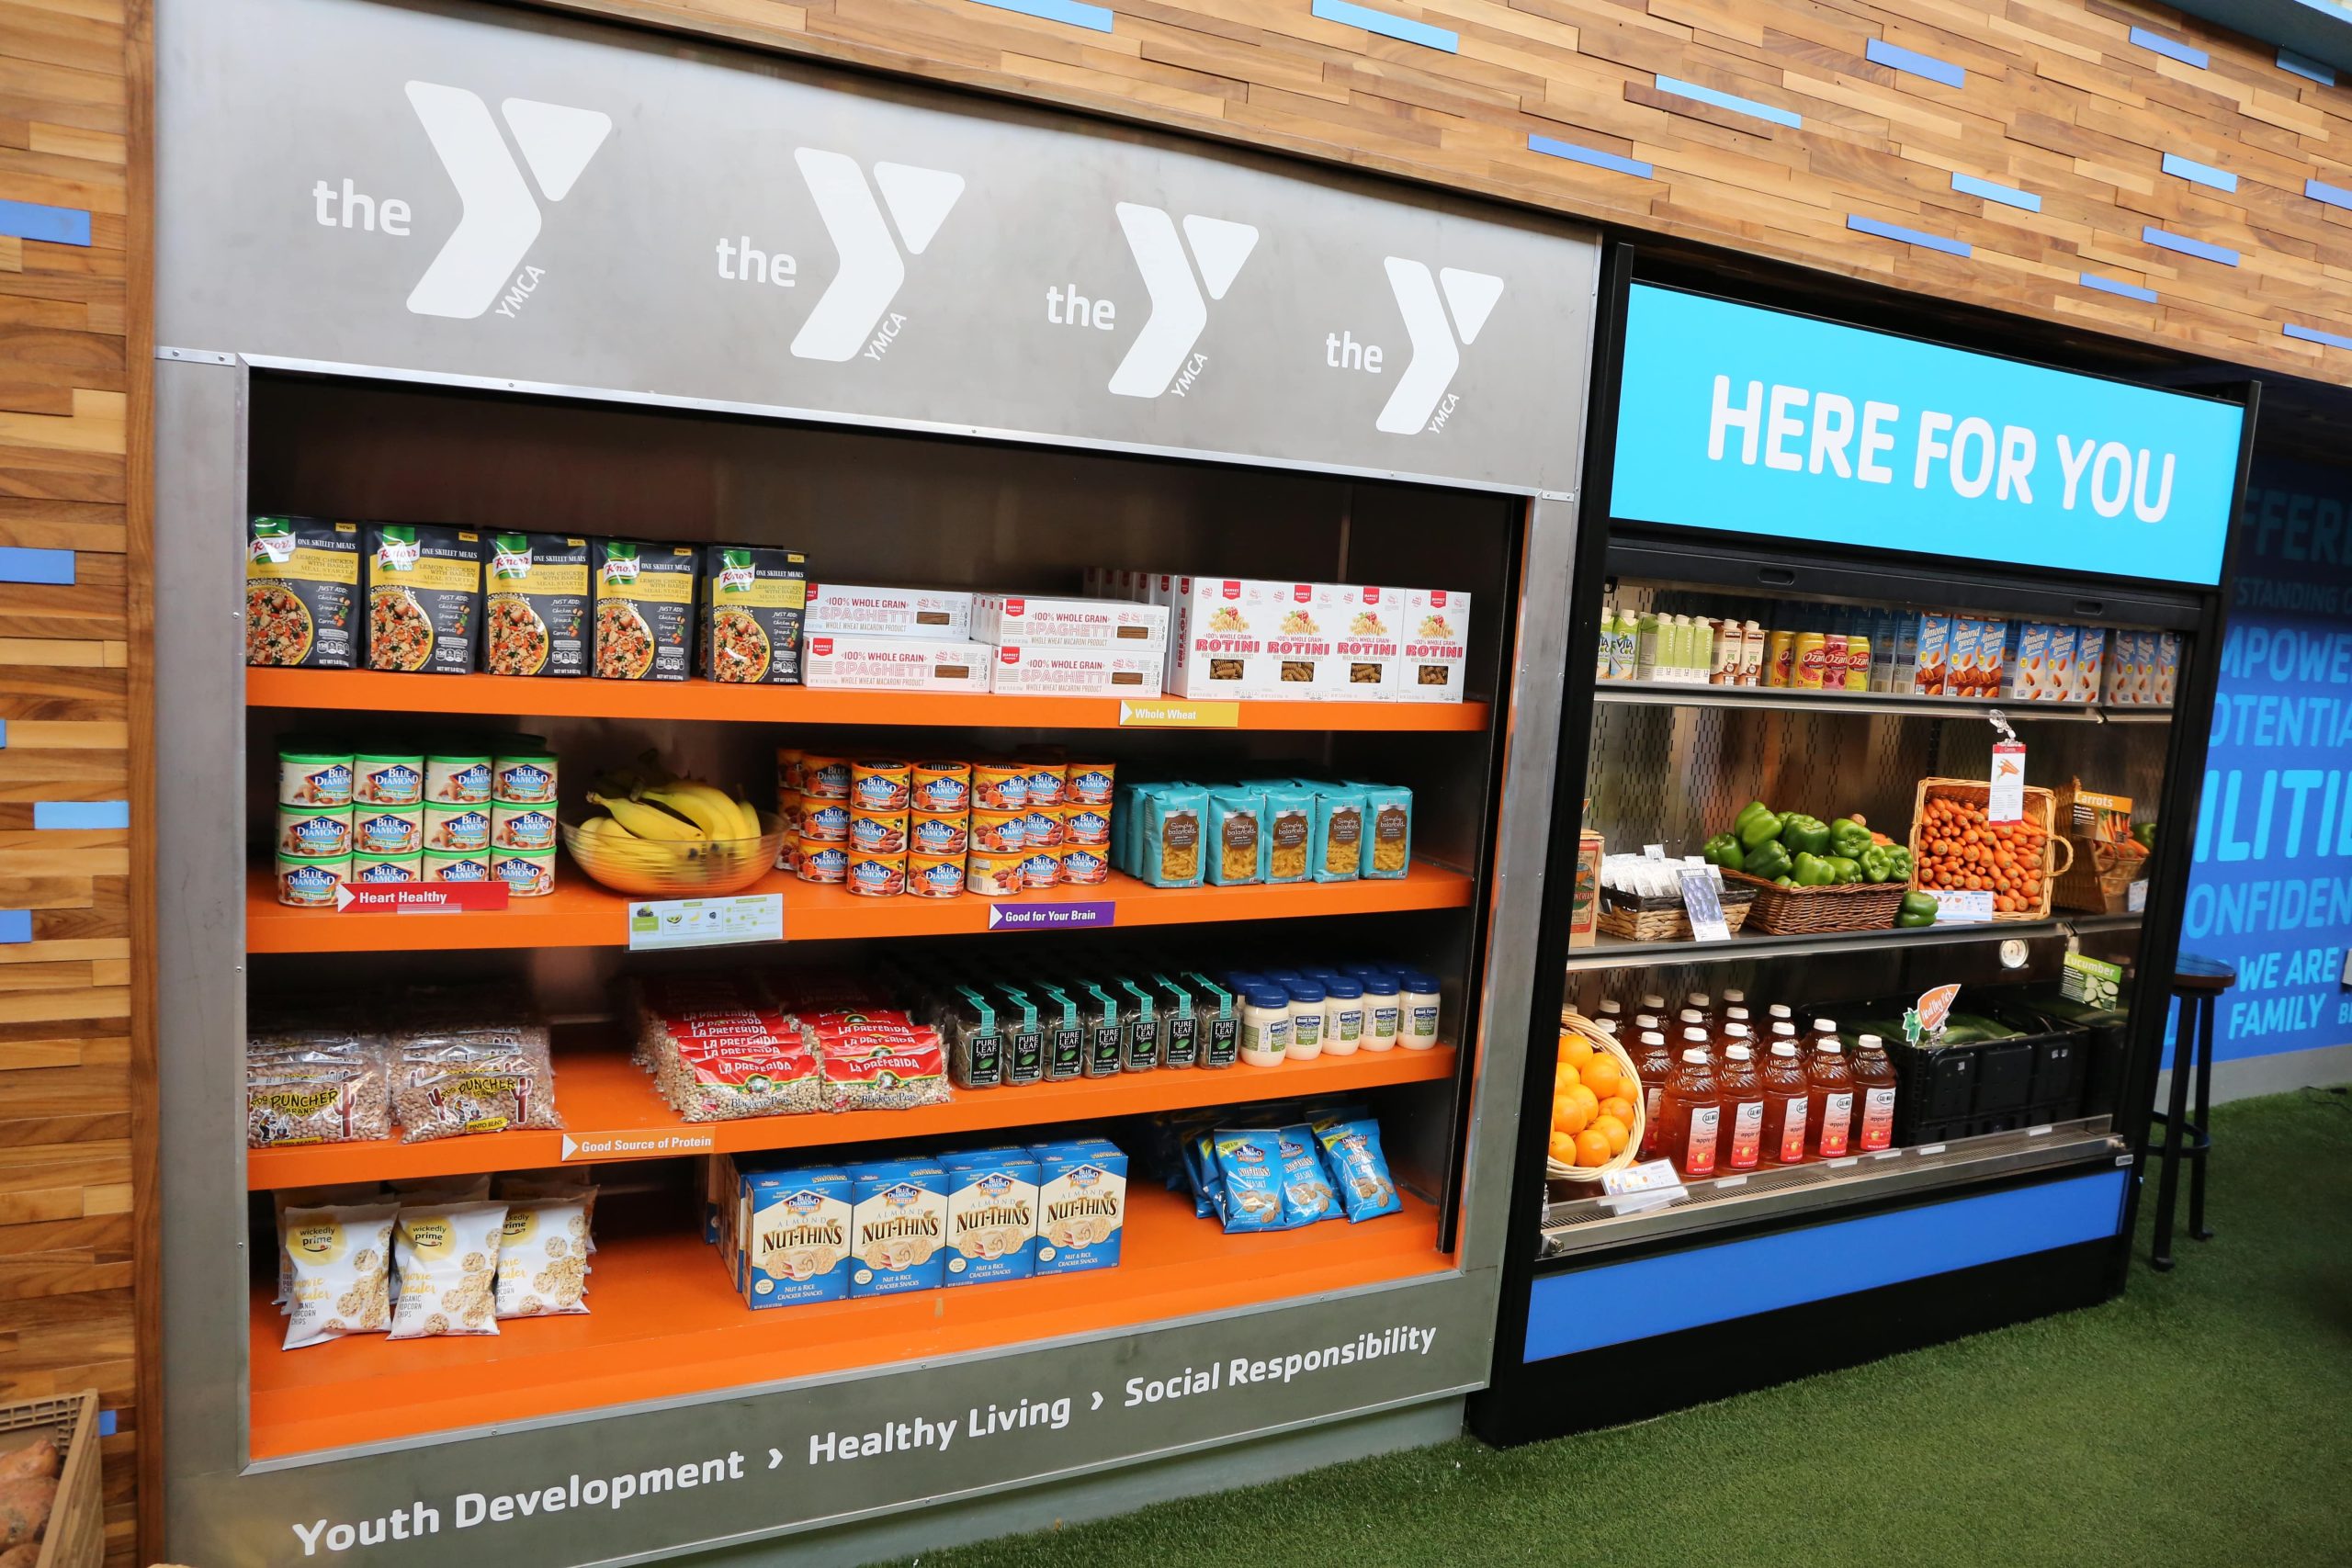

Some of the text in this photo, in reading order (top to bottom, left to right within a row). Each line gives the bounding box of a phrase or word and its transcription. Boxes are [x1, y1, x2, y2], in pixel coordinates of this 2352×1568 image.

[312, 177, 411, 236] the
[716, 235, 797, 288] the
[495, 265, 547, 320] YMCA
[1046, 283, 1115, 331] the
[864, 311, 908, 363] YMCA
[1326, 331, 1384, 373] the
[1170, 353, 1208, 399] YMCA
[1428, 392, 1460, 435] YMCA
[1707, 375, 2176, 523] HERE FOR YOU
[311, 539, 334, 549] SKILLET
[336, 541, 356, 549] MEALS
[435, 548, 458, 557] SKILLET
[458, 550, 478, 558] MEALS
[829, 597, 907, 608] 100% WHOLE GRAIN
[819, 606, 915, 624] SPAGHETTI
[1035, 612, 1108, 623] 100% WHOLE GRAIN
[1025, 622, 1116, 637] SPAGHETTI
[1195, 638, 1261, 653] ROTINI
[1267, 641, 1330, 655] ROTINI
[1337, 642, 1397, 656] ROTINI
[844, 651, 924, 662] 100% WHOLE GRAIN
[1406, 645, 1463, 658] ROTINI
[833, 661, 933, 678] SPAGHETTI
[1029, 660, 1102, 670] 100% WHOLE GRAIN
[1020, 669, 1110, 684] SPAGHETTI
[1135, 708, 1196, 721] Whole Wheat
[389, 769, 410, 778] BLUE
[516, 768, 538, 776] BLUE
[375, 775, 418, 785] DIAMOND
[505, 774, 548, 784] DIAMOND
[867, 778, 888, 787] BLUE
[936, 780, 956, 788] BLUE
[1076, 779, 1110, 787] DIAMOND
[858, 784, 897, 794] DIAMOND
[926, 785, 964, 795] DIAMOND
[2075, 793, 2113, 807] Carrots
[310, 820, 334, 829] BLUE
[1383, 815, 1403, 824] Simply
[297, 826, 345, 836] DIAMOND
[925, 822, 944, 831] BLUE
[1168, 828, 1197, 836] balanced
[1170, 822, 1194, 832] Simply
[1227, 828, 1257, 836] balanced
[1229, 822, 1253, 831] Simply
[917, 828, 955, 837] DIAMOND
[497, 866, 539, 876] DIAMOND
[506, 862, 528, 871] BLUE
[862, 863, 881, 872] BLUE
[299, 870, 323, 879] BLUE
[853, 868, 891, 878] DIAMOND
[288, 875, 335, 886] DIAMOND
[359, 891, 447, 905] Heart Healthy
[1005, 909, 1096, 922] Good for Your Brain
[2064, 953, 2115, 977] Cucumber
[2239, 947, 2339, 992] WE ARE
[2228, 992, 2327, 1040] FAMILY
[1216, 1021, 1235, 1030] PURE
[1059, 1032, 1080, 1040] PURE
[703, 1036, 778, 1050] LA PREFERIDA
[976, 1039, 997, 1047] PURE
[1058, 1038, 1080, 1046] LEAF
[976, 1045, 997, 1055] LEAF
[718, 1061, 792, 1075] LA PREFERIDA
[849, 1058, 921, 1073] LA PREFERIDA
[458, 1077, 515, 1094] PUNCHER
[271, 1090, 338, 1108] PUNCHER
[861, 1092, 916, 1103] Blackeye Peas
[582, 1135, 712, 1153] Good Source of Protein
[300, 1226, 335, 1237] wickedly
[413, 1224, 447, 1235] wickedly
[302, 1235, 333, 1247] prime
[414, 1232, 443, 1241] prime
[876, 1280, 920, 1291] CRACKER SNACKS
[1125, 1324, 1437, 1408] Social Responsibility
[808, 1393, 1072, 1465] Healthy Living
[292, 1450, 745, 1556] Youth Development
